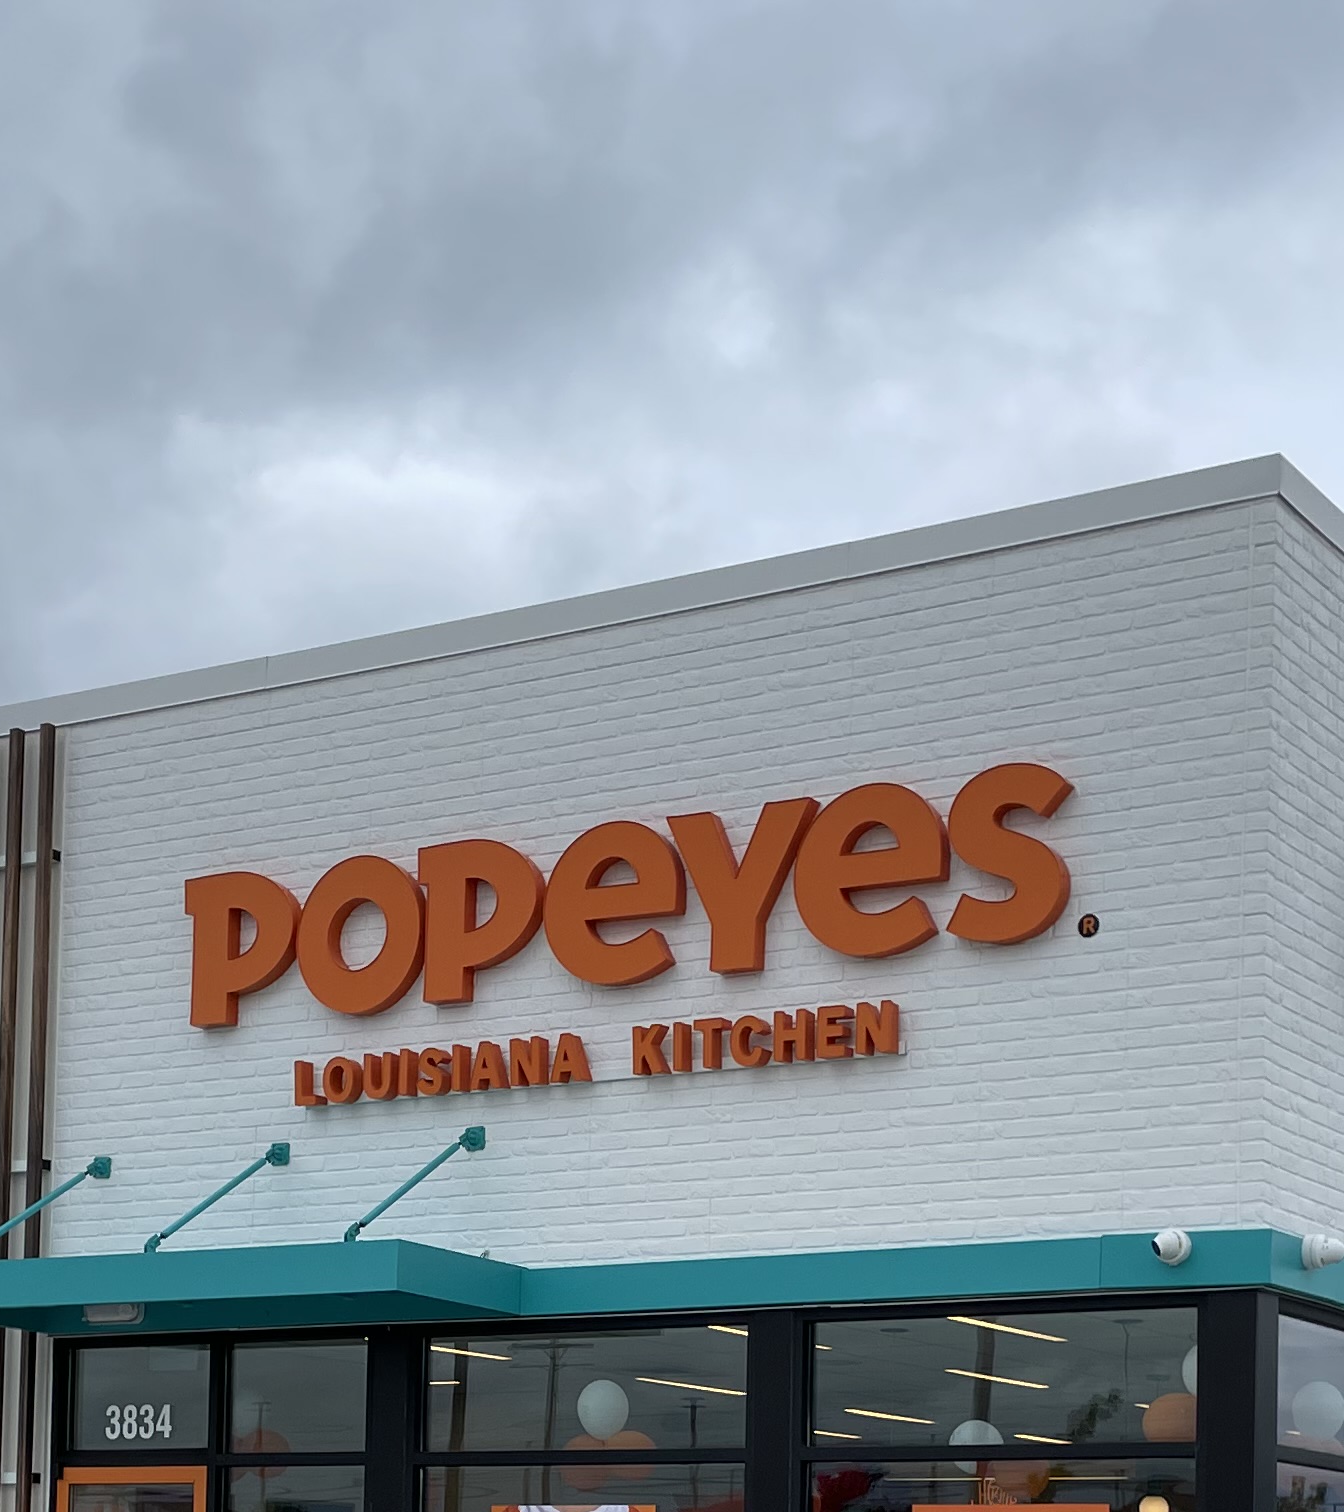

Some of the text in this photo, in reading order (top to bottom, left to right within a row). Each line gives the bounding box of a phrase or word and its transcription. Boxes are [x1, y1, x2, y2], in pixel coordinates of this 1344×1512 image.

[294, 1000, 899, 1107] LOUISIANA KITCHEN
[105, 1403, 173, 1440] 3834
